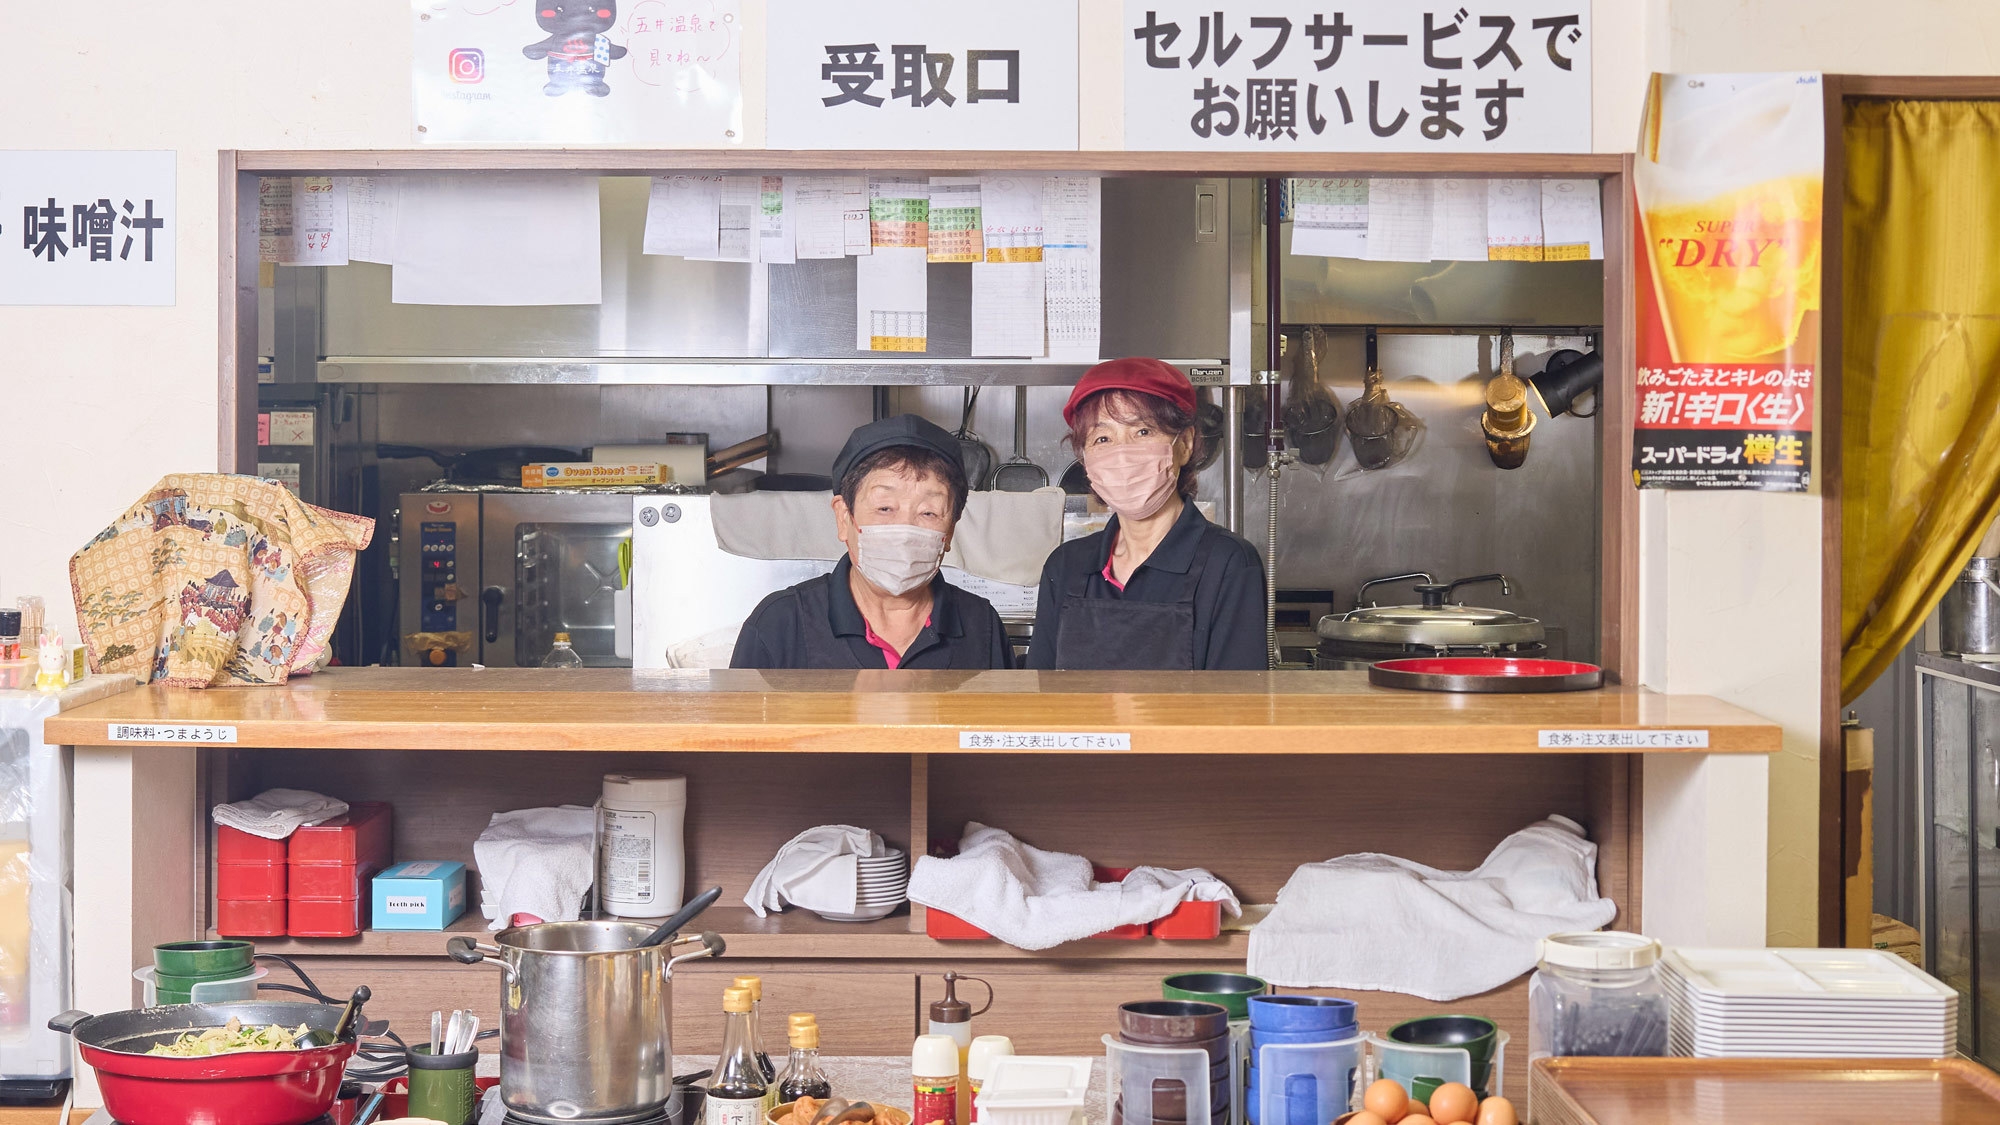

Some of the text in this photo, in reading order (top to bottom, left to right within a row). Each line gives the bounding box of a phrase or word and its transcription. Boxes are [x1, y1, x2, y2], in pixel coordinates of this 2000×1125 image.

[1133, 9, 1581, 71] セルフサービスで
[821, 44, 1020, 108] 受取口
[1190, 77, 1525, 141] お願いします
[24, 198, 164, 262] 味噌汁
[1637, 367, 1811, 388] 飲みごたえとキレのよさ
[564, 467, 591, 476] Oven
[592, 466, 625, 476] Sheet
[117, 726, 227, 740] 調味料・つまようじ
[968, 734, 1121, 748] 食券・注文表出して下さい
[1548, 732, 1699, 746] 食券・注文表出して下さい
